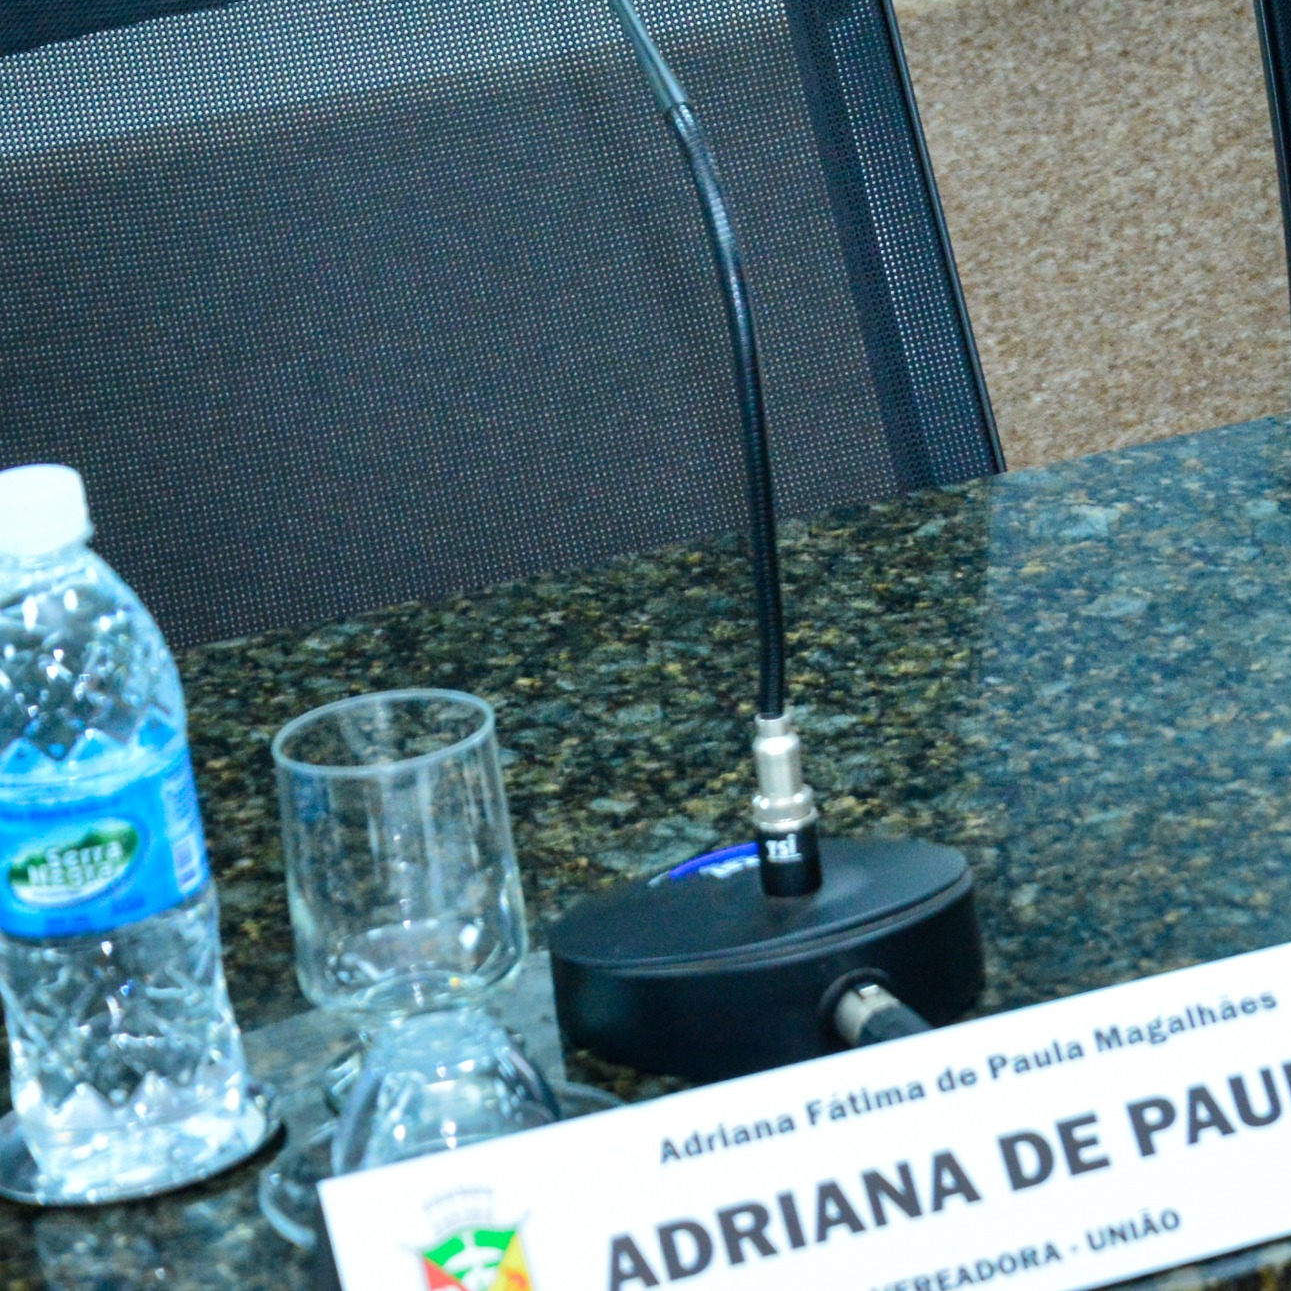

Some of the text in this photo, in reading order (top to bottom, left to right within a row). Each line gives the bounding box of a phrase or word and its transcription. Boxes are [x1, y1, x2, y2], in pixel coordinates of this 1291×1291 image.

[660, 991, 1277, 1164] Adriana Fátima de Paula Magalhães
[608, 1150, 983, 1291] ADRIANA
[997, 1112, 1111, 1192] DE
[1086, 1208, 1181, 1253] UNIÃO
